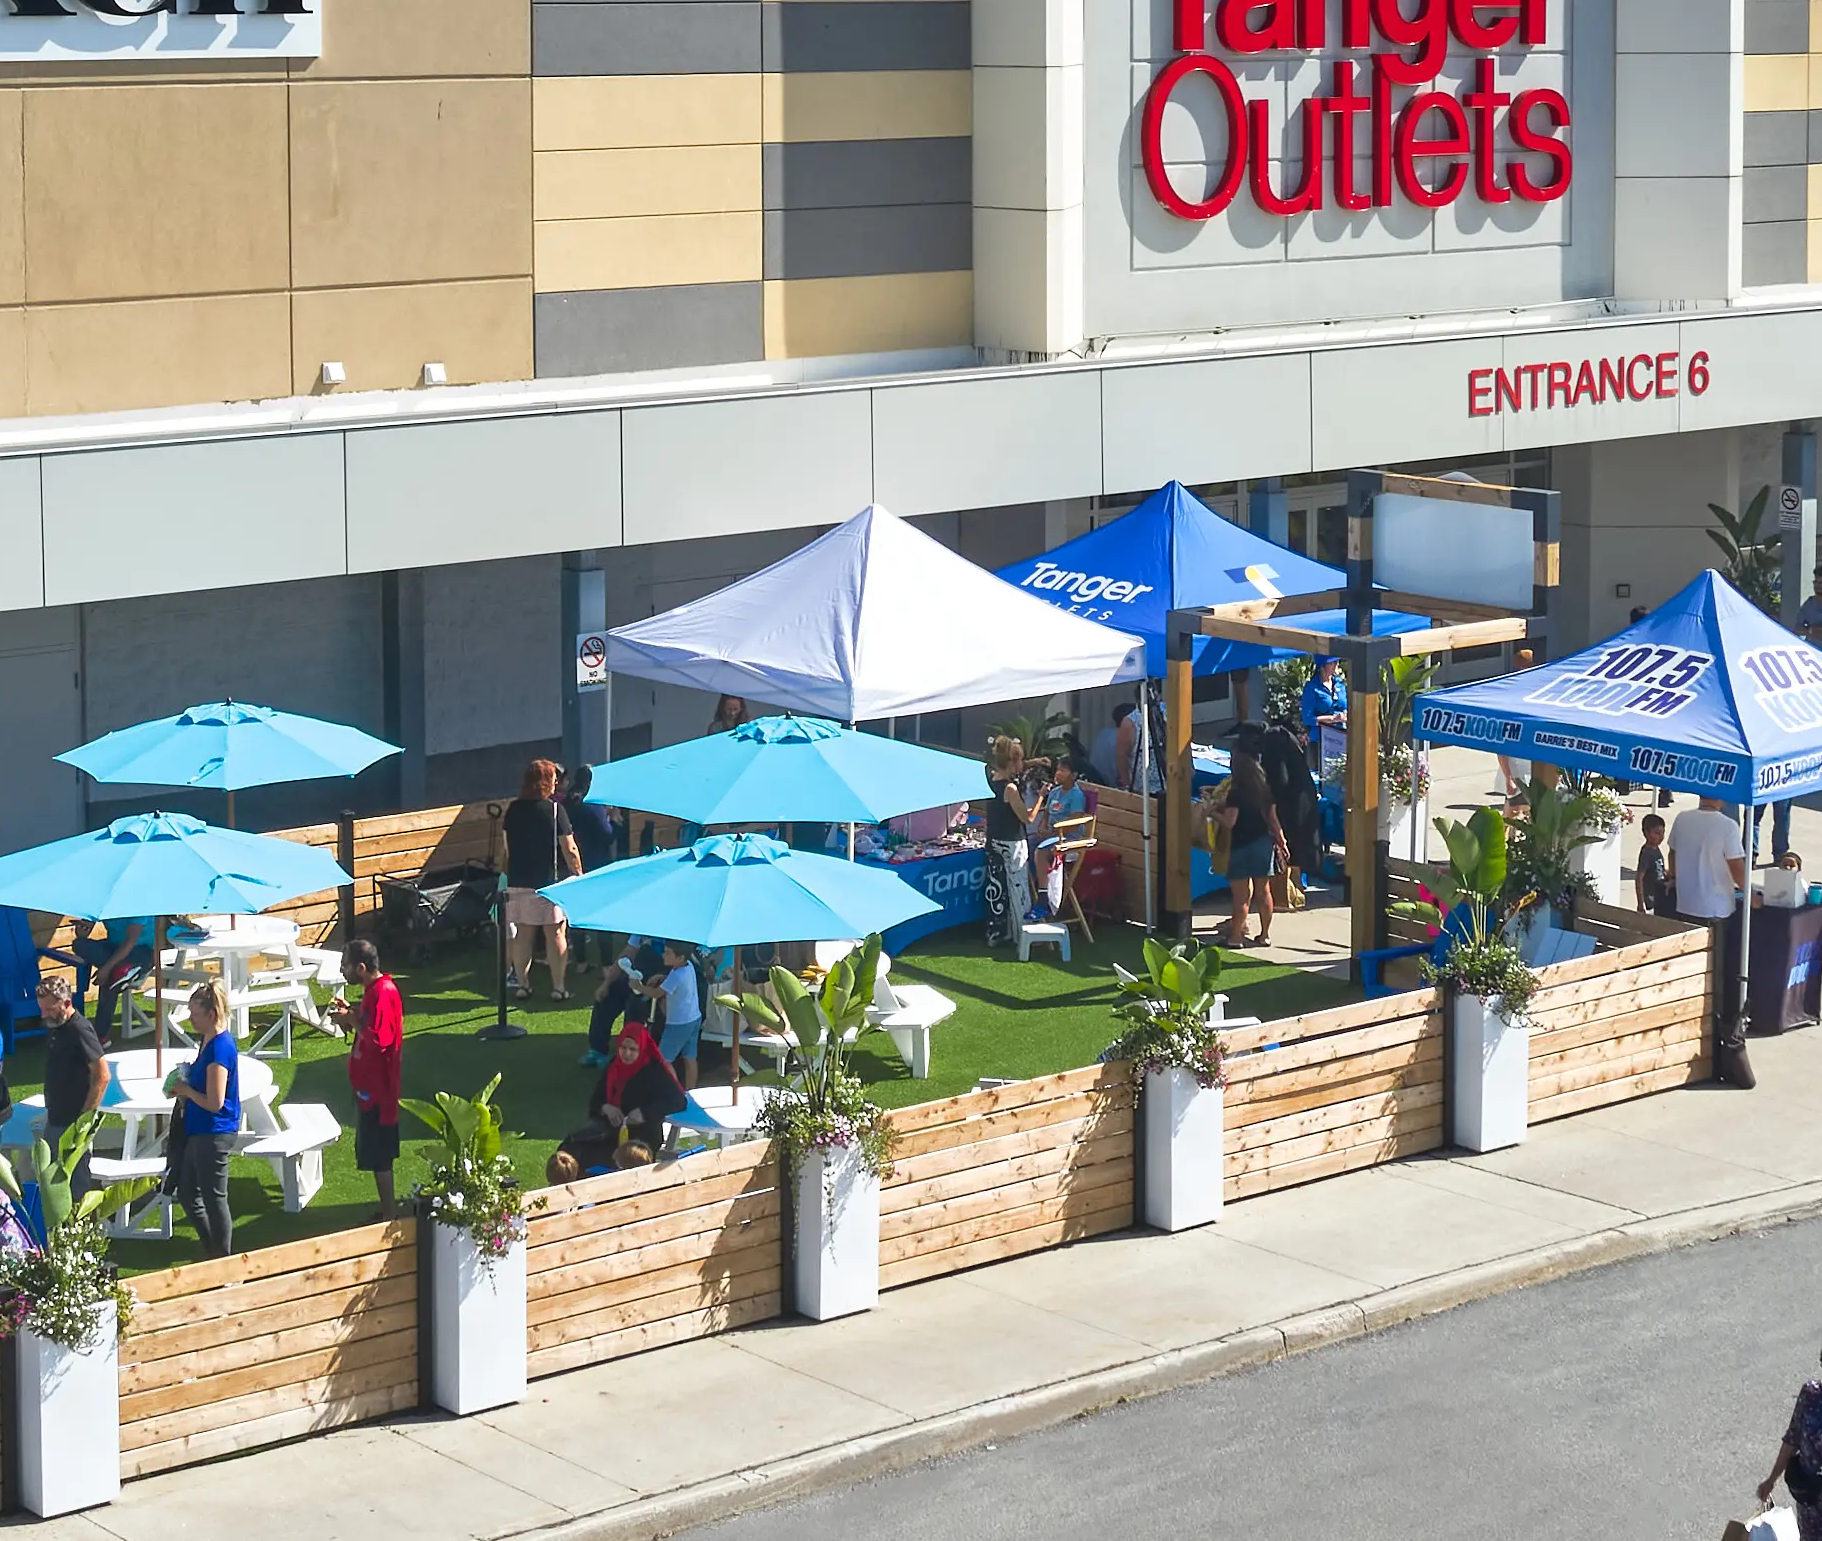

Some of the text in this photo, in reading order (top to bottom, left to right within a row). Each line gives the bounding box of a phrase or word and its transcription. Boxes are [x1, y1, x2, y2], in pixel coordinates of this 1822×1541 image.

[1141, 53, 1572, 221] Outlets
[1469, 351, 1710, 417] ENTRANCE 6
[1021, 562, 1154, 603] Tanger
[1587, 647, 1710, 689] 107.5
[1535, 733, 1618, 758] BARRIE'S BEST MIX
[923, 866, 987, 896] Tang
